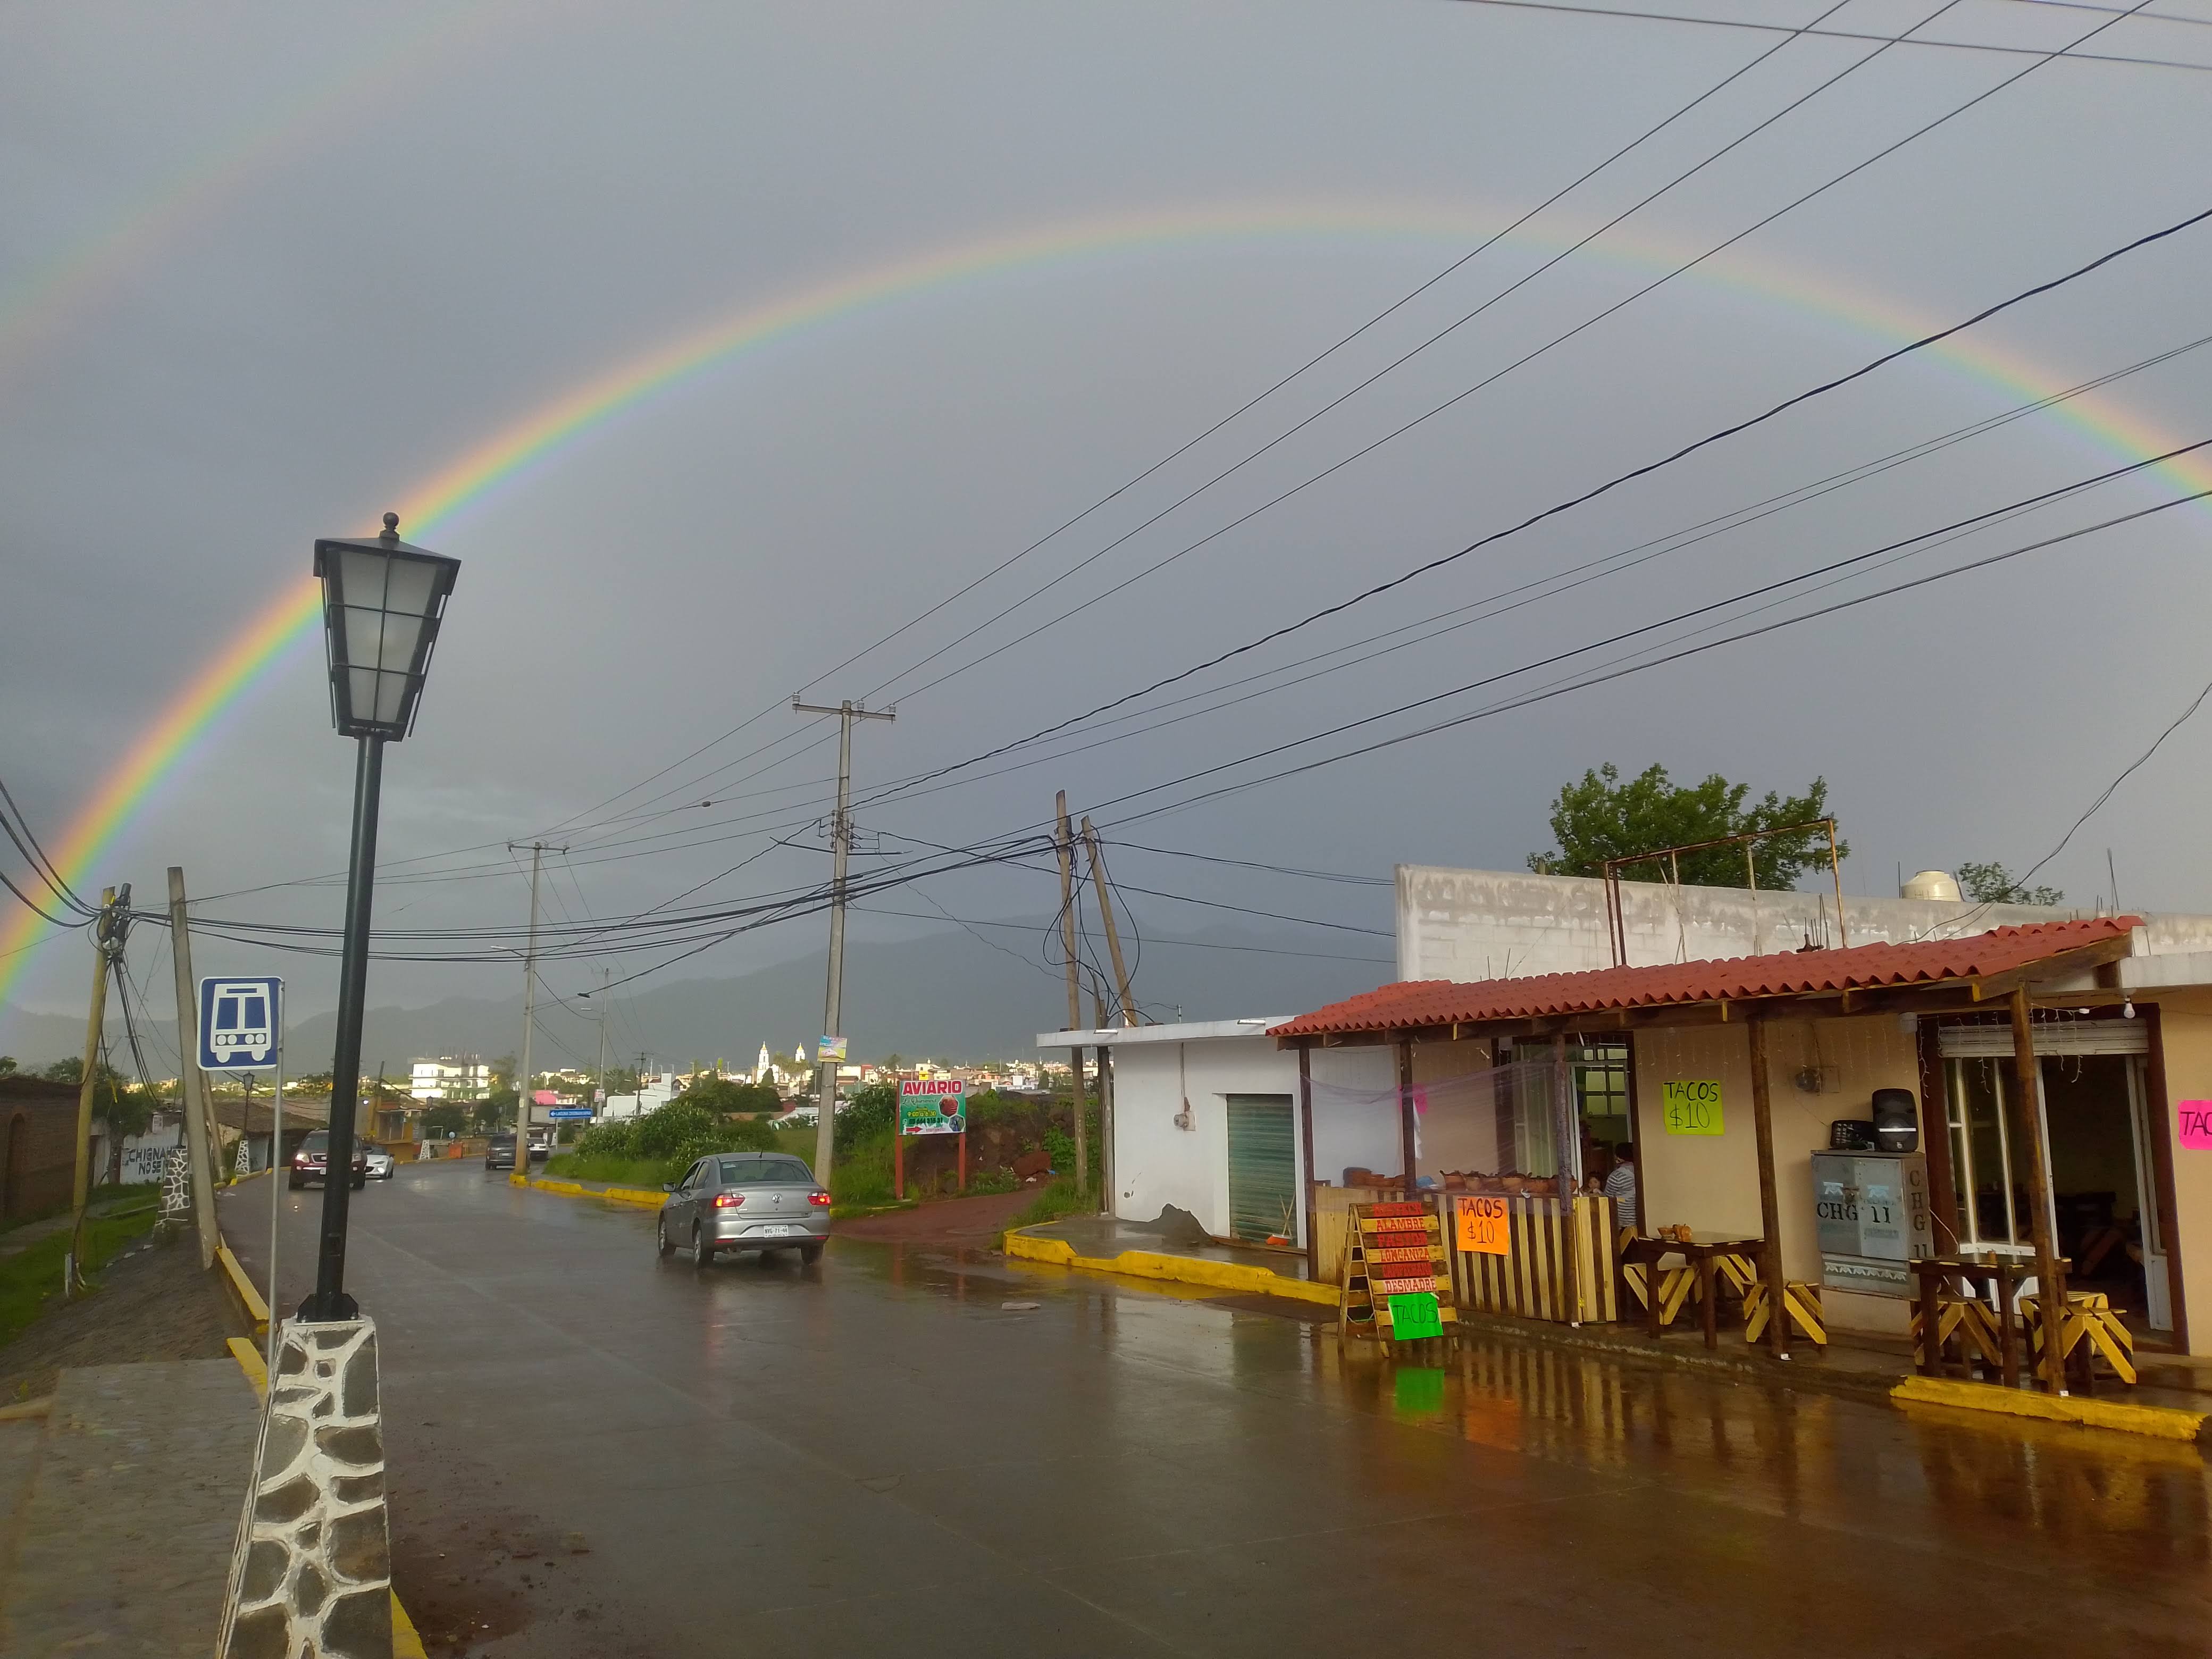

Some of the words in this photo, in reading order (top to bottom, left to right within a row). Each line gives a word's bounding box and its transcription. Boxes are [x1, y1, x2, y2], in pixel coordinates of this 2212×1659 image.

[902, 1080, 962, 1095] AVIARIO
[1663, 1082, 1719, 1102] TACOS
[1670, 1102, 1710, 1129] $10
[1458, 1198, 1503, 1219] TACOS
[1817, 1202, 1858, 1221] CHG
[1871, 1206, 1891, 1224] 11
[1377, 1218, 1426, 1231] ALAMBRE
[1468, 1220, 1495, 1243] $10
[1380, 1248, 1430, 1262] LONGANIZA
[1385, 1278, 1437, 1293] DESMADRE
[1392, 1302, 1438, 1325] TACOS
